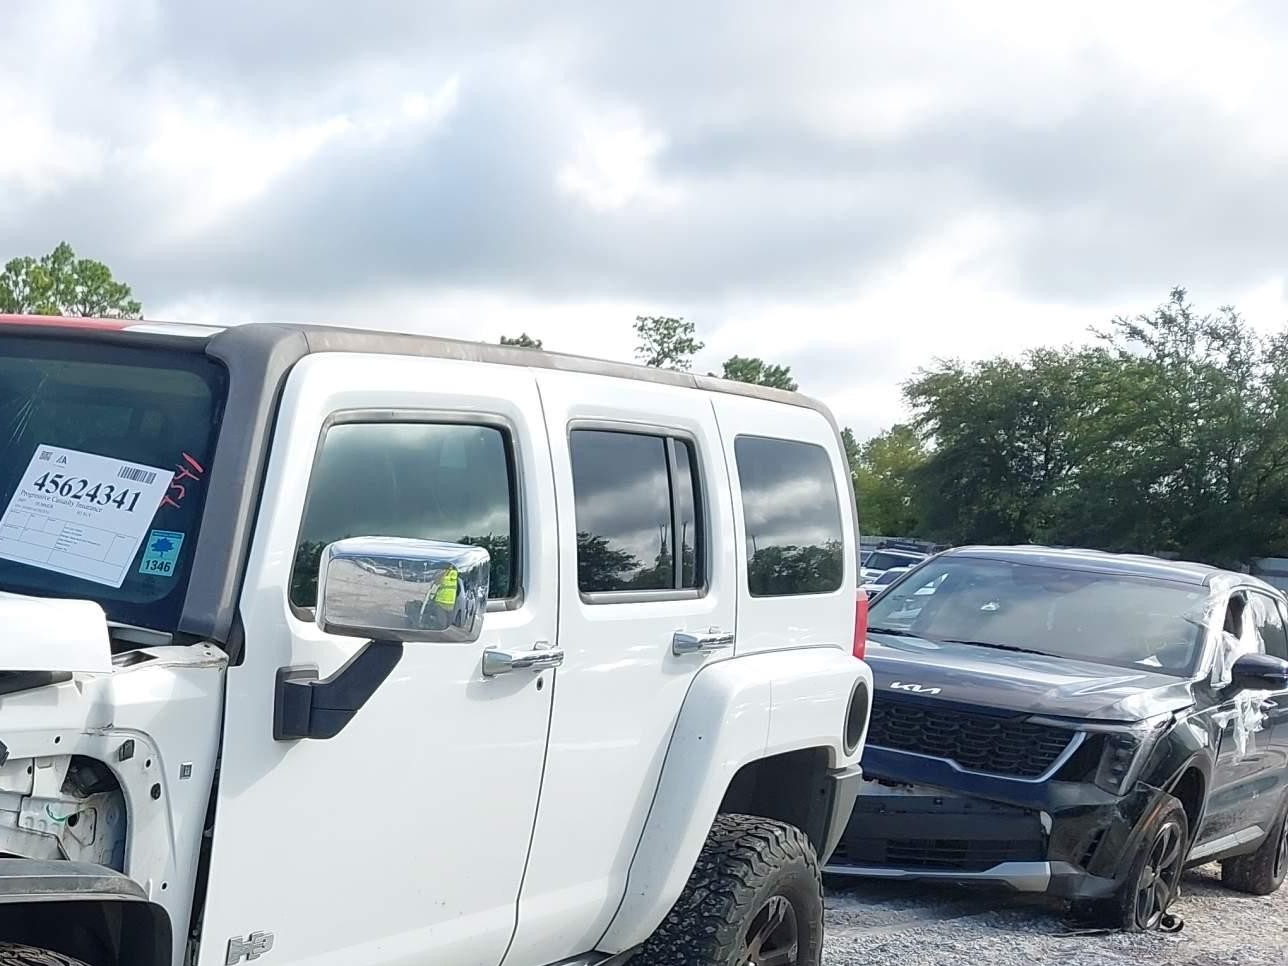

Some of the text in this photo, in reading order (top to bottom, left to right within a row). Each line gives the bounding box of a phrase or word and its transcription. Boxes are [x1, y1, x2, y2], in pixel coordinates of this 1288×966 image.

[33, 471, 142, 513] 45624341
[75, 502, 104, 514] Insurance
[144, 559, 172, 573] 1346
[224, 930, 275, 966] H3
